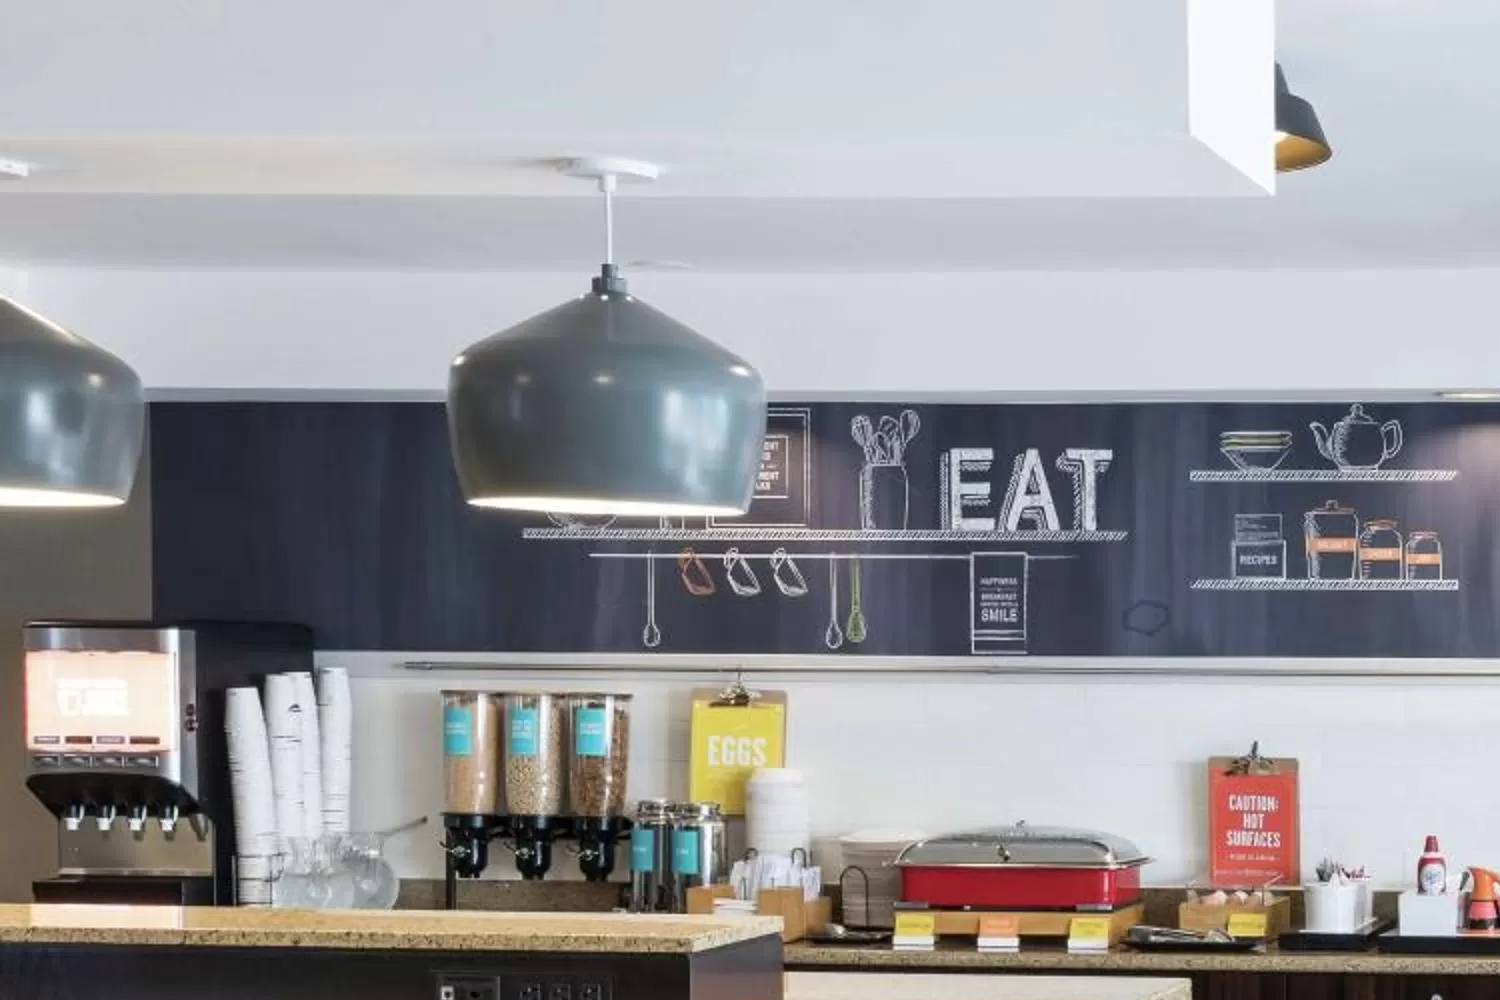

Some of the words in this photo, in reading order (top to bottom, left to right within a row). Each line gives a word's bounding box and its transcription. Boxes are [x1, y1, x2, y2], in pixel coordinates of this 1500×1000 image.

[940, 447, 1113, 531] EAT
[1239, 554, 1278, 566] RECIPES
[981, 607, 1019, 623] SMILE
[707, 735, 767, 767] EGGS
[1228, 794, 1279, 811] CAUTION:
[1243, 813, 1265, 829] HOT
[1226, 831, 1281, 848] SURFACES
